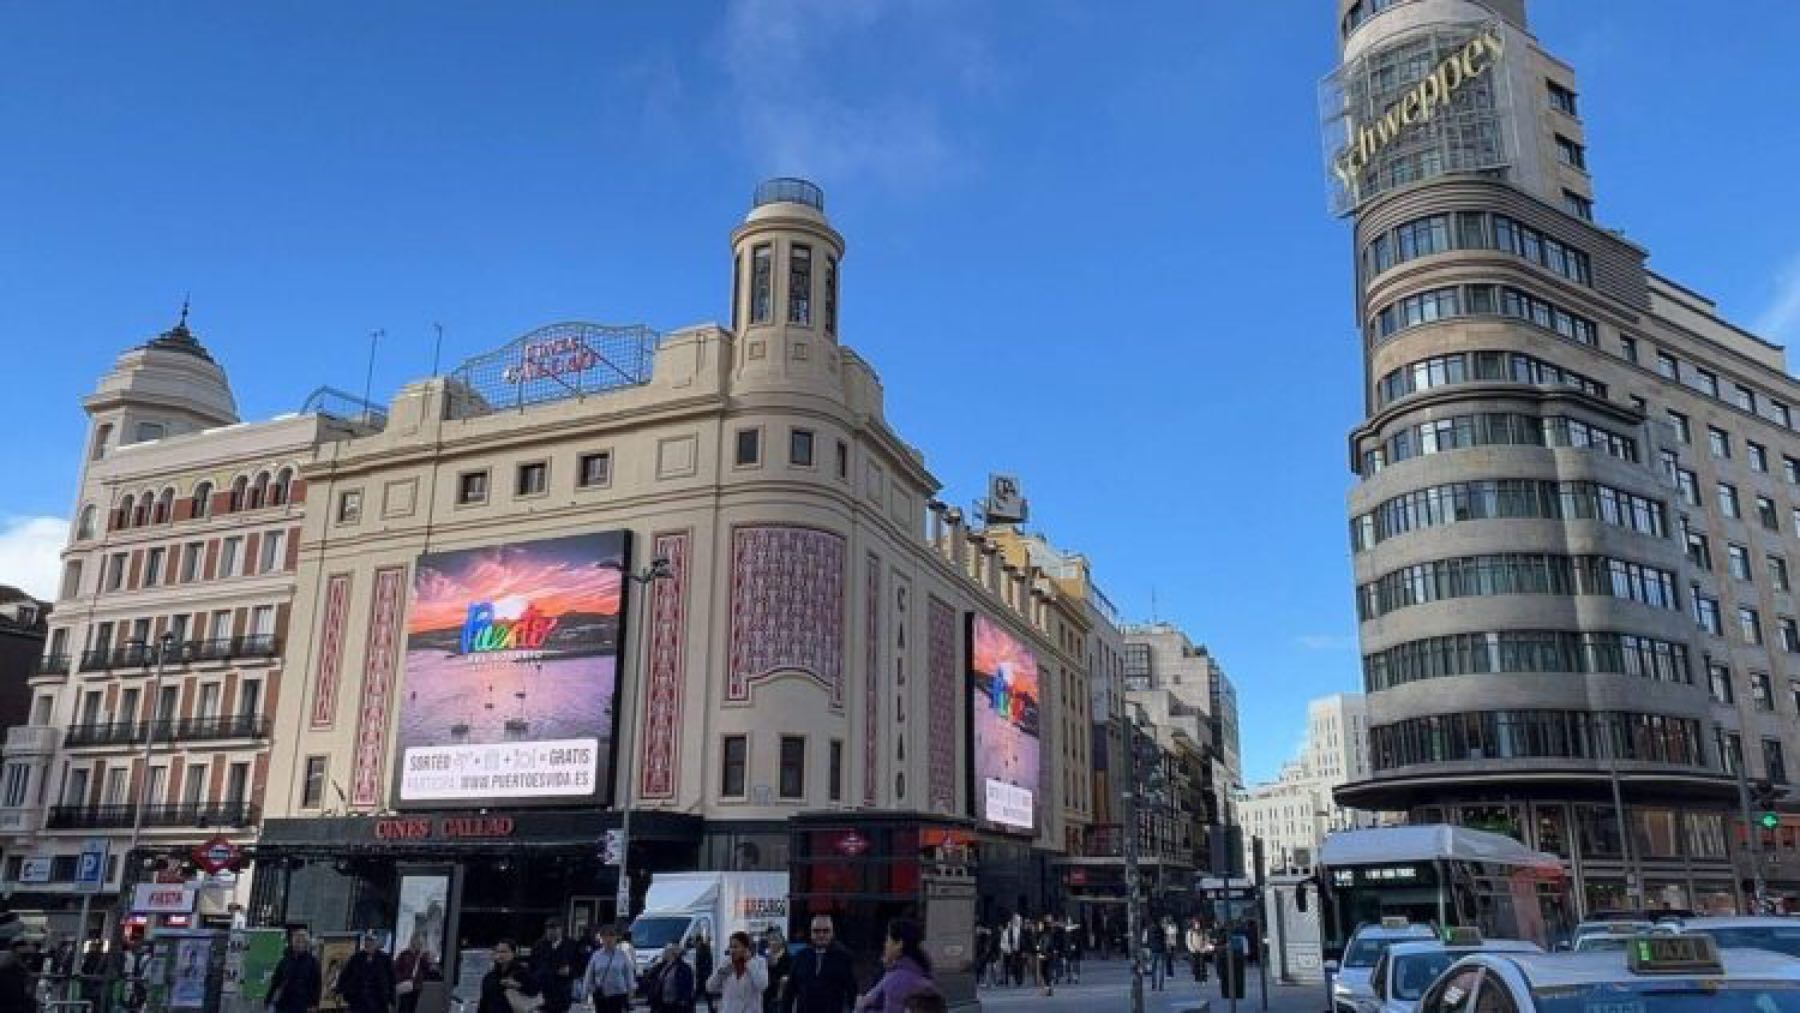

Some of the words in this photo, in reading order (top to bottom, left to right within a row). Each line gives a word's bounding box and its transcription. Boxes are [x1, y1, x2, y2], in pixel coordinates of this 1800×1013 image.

[1333, 28, 1504, 192] Schweppes
[410, 755, 450, 771] SORTEO
[549, 748, 591, 766] GRATIS
[376, 818, 429, 838] CINES
[442, 816, 515, 837] CALLAO
